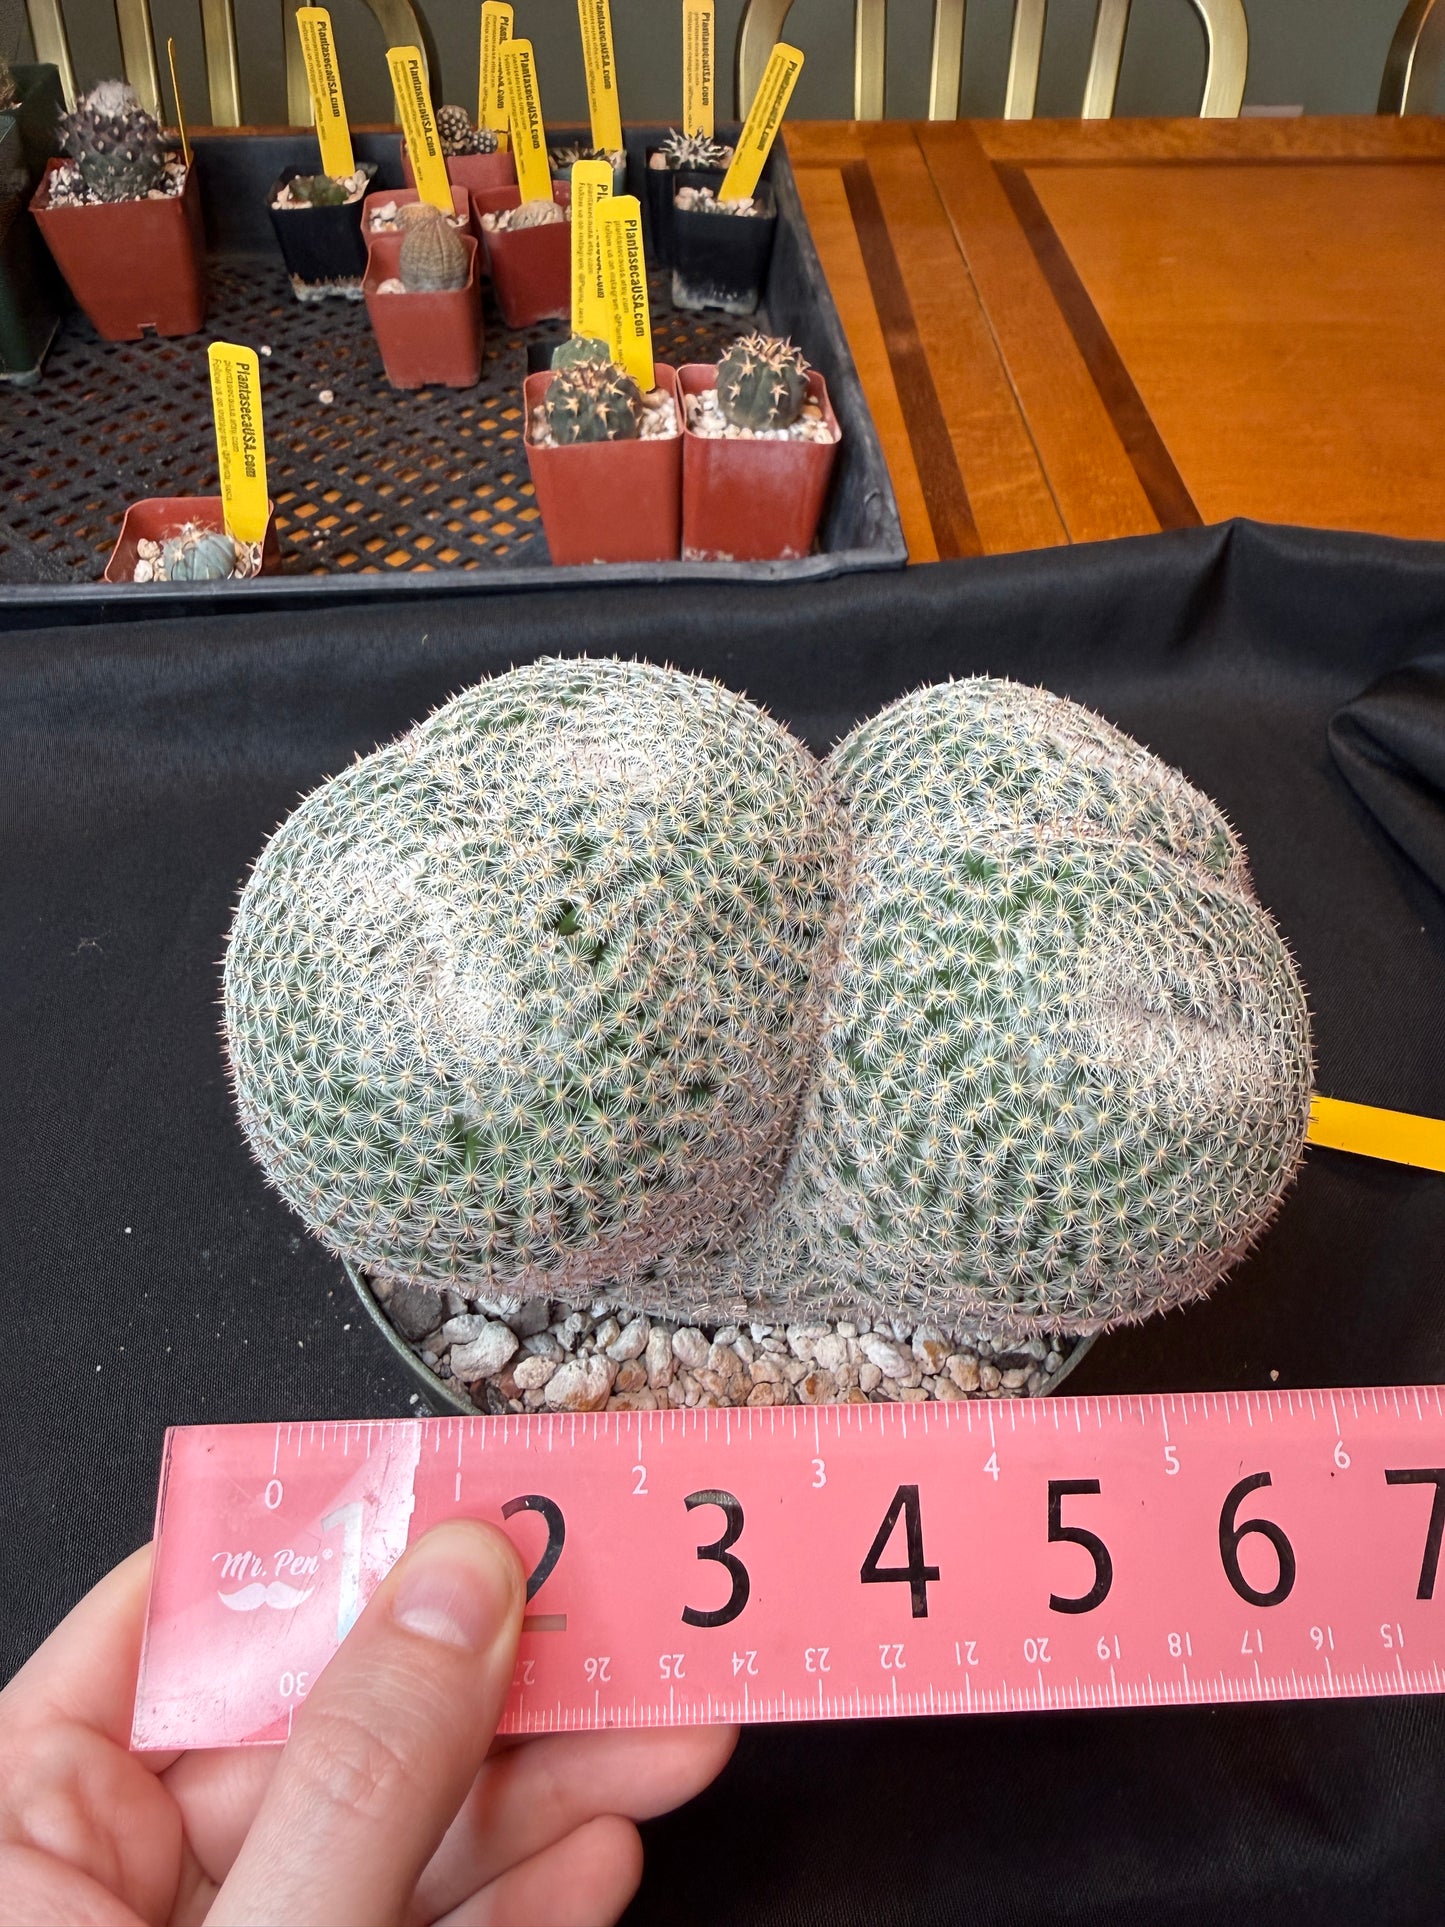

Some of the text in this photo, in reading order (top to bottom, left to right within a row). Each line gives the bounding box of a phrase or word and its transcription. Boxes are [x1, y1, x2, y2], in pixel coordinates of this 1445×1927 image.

[520, 52, 541, 149] PlantasecaUSA.com
[625, 219, 646, 337] PlantasecaUSA.com
[237, 362, 257, 478] PlantasecaUSA.com
[265, 1440, 1351, 1509] 0 1 2 3 4 5 6
[212, 1550, 267, 1581] Mr.
[321, 1467, 1445, 1641] 1 2 3 4 5 6 7
[1096, 1633, 1121, 1660] 19
[1168, 1631, 1192, 1657] 18
[1240, 1628, 1262, 1654] 17
[1310, 1625, 1334, 1650] 16
[1380, 1622, 1403, 1648] 15
[731, 1649, 757, 1676] 24
[804, 1646, 831, 1672] 23
[879, 1643, 906, 1669] 22
[955, 1640, 980, 1666] 21
[1023, 1637, 1051, 1663] 20
[584, 1655, 611, 1682] 26
[659, 1653, 685, 1679] 25
[279, 1671, 309, 1697] 30
